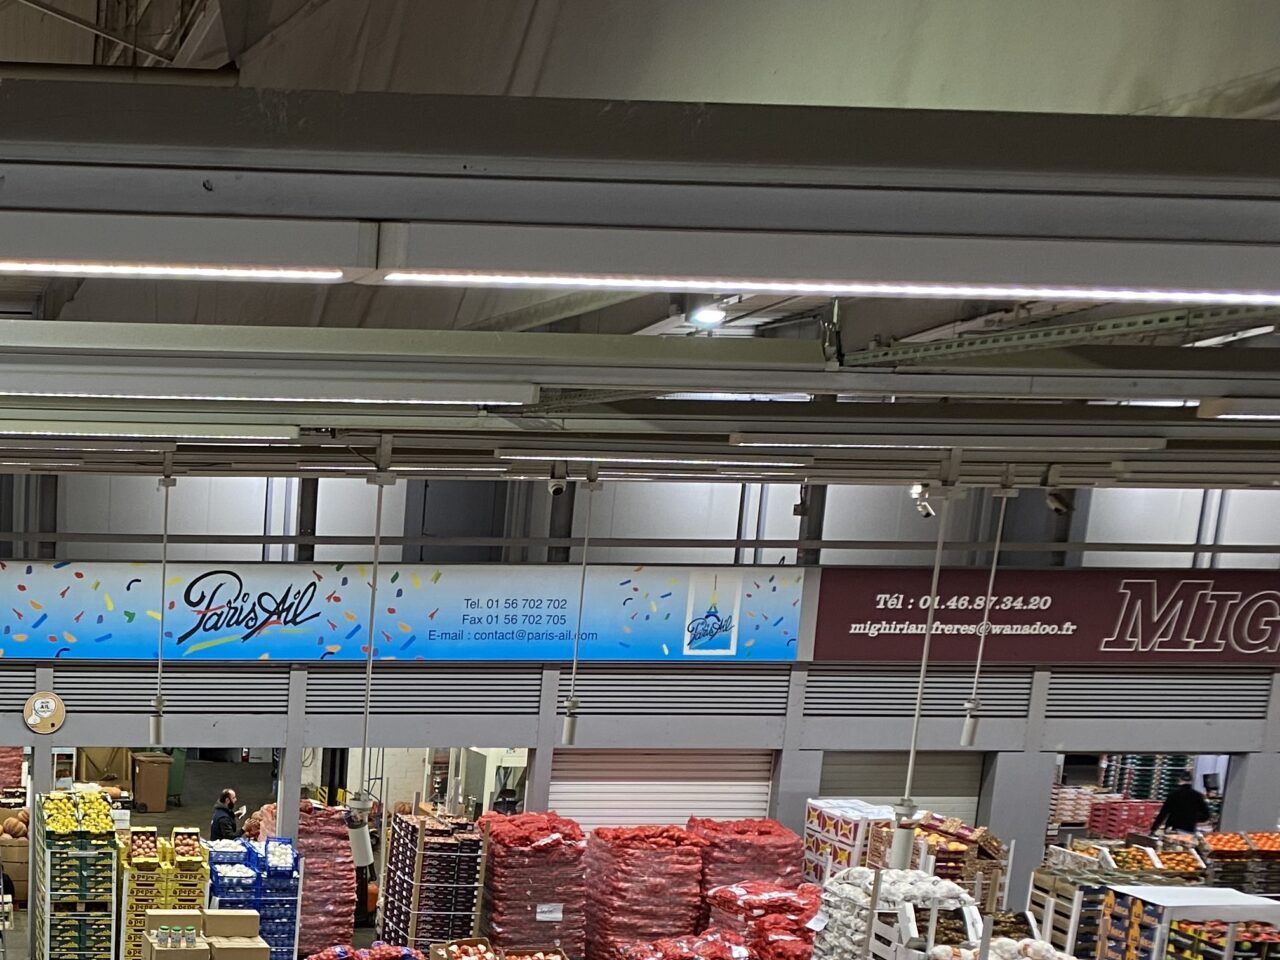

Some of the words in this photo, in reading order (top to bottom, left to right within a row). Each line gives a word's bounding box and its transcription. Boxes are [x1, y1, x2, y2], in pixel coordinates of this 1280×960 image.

[176, 570, 257, 645] Paris
[241, 581, 321, 643] Ail
[464, 598, 483, 609] Tel.
[486, 599, 499, 609] 01
[503, 599, 518, 609] 56
[522, 599, 543, 609] 702
[546, 599, 568, 610] 702
[876, 593, 904, 609] Tél
[918, 596, 1052, 610] 01.46.87.34.20
[462, 614, 483, 625] Fax
[486, 615, 499, 625] 01
[503, 615, 518, 625] 56
[521, 615, 542, 625] 702
[546, 615, 567, 625] 705
[1100, 579, 1280, 654] MIG
[428, 630, 464, 640] E-mail
[473, 630, 598, 645] contact@paris-ail.com
